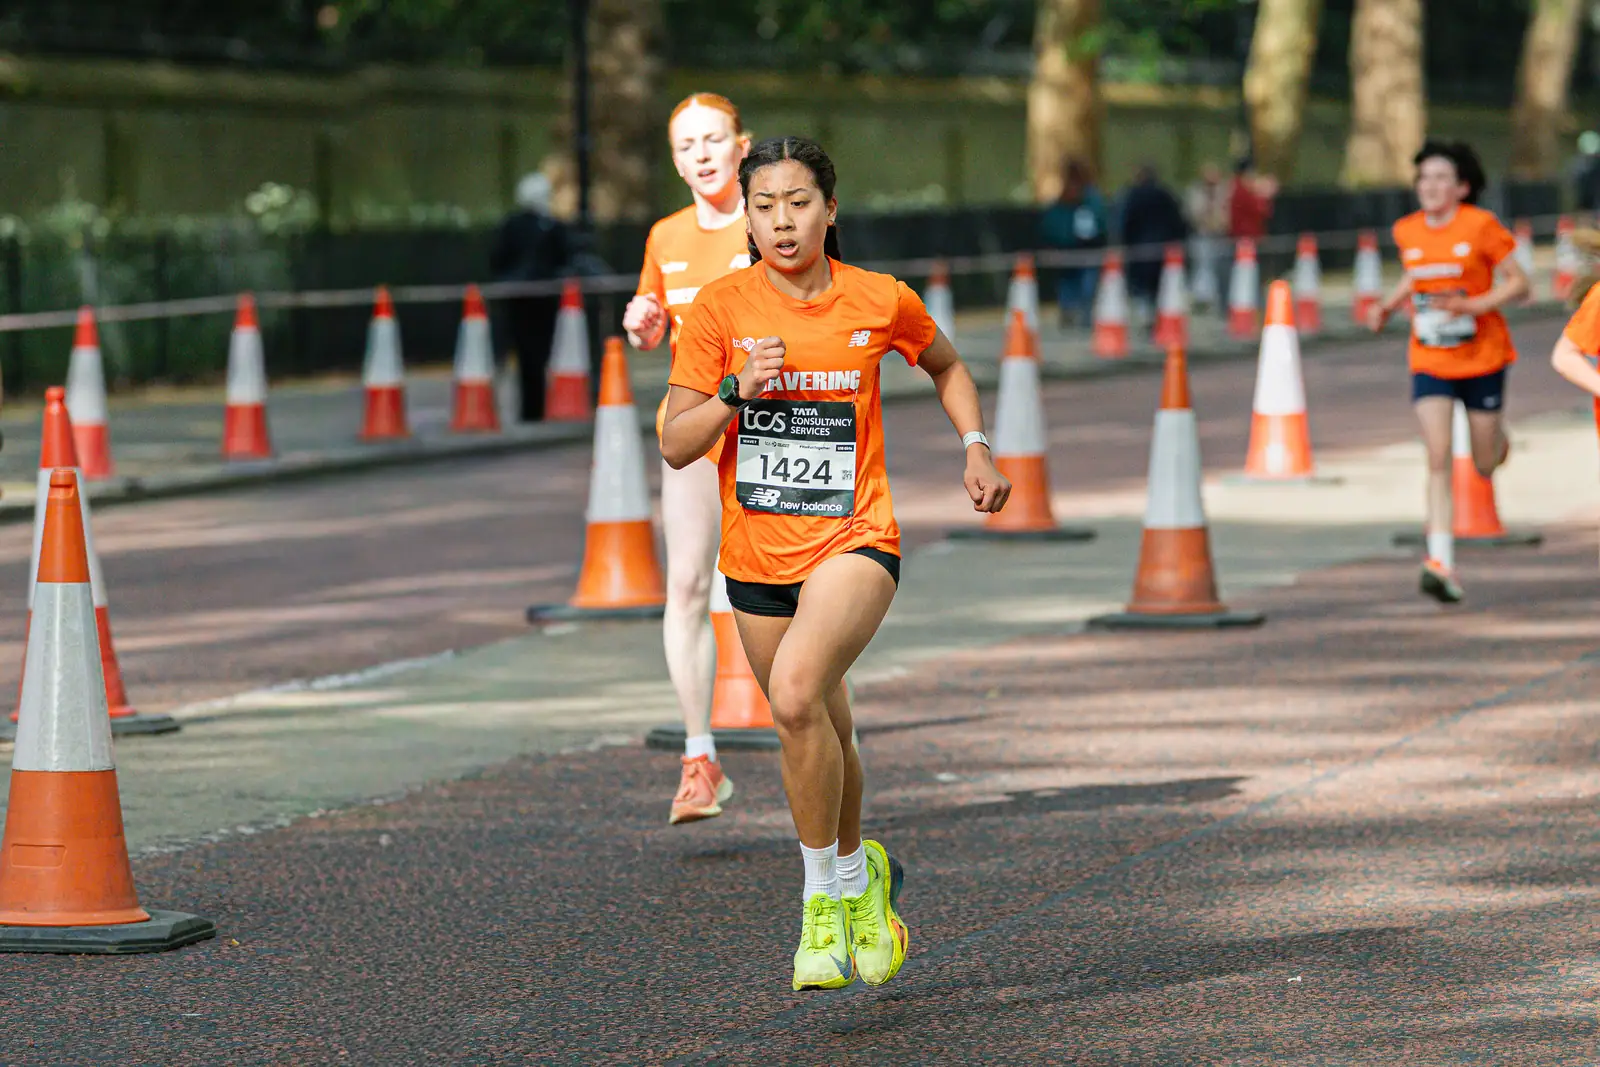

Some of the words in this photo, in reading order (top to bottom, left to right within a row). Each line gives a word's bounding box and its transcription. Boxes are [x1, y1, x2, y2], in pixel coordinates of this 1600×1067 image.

[763, 370, 861, 391] AVERING
[792, 408, 818, 416] TATA
[744, 406, 786, 432] tcs
[791, 417, 853, 427] CONSULTANCY
[790, 427, 830, 436] SERVICES
[760, 454, 832, 485] 1424
[780, 501, 800, 510] new
[801, 501, 843, 512] balance
